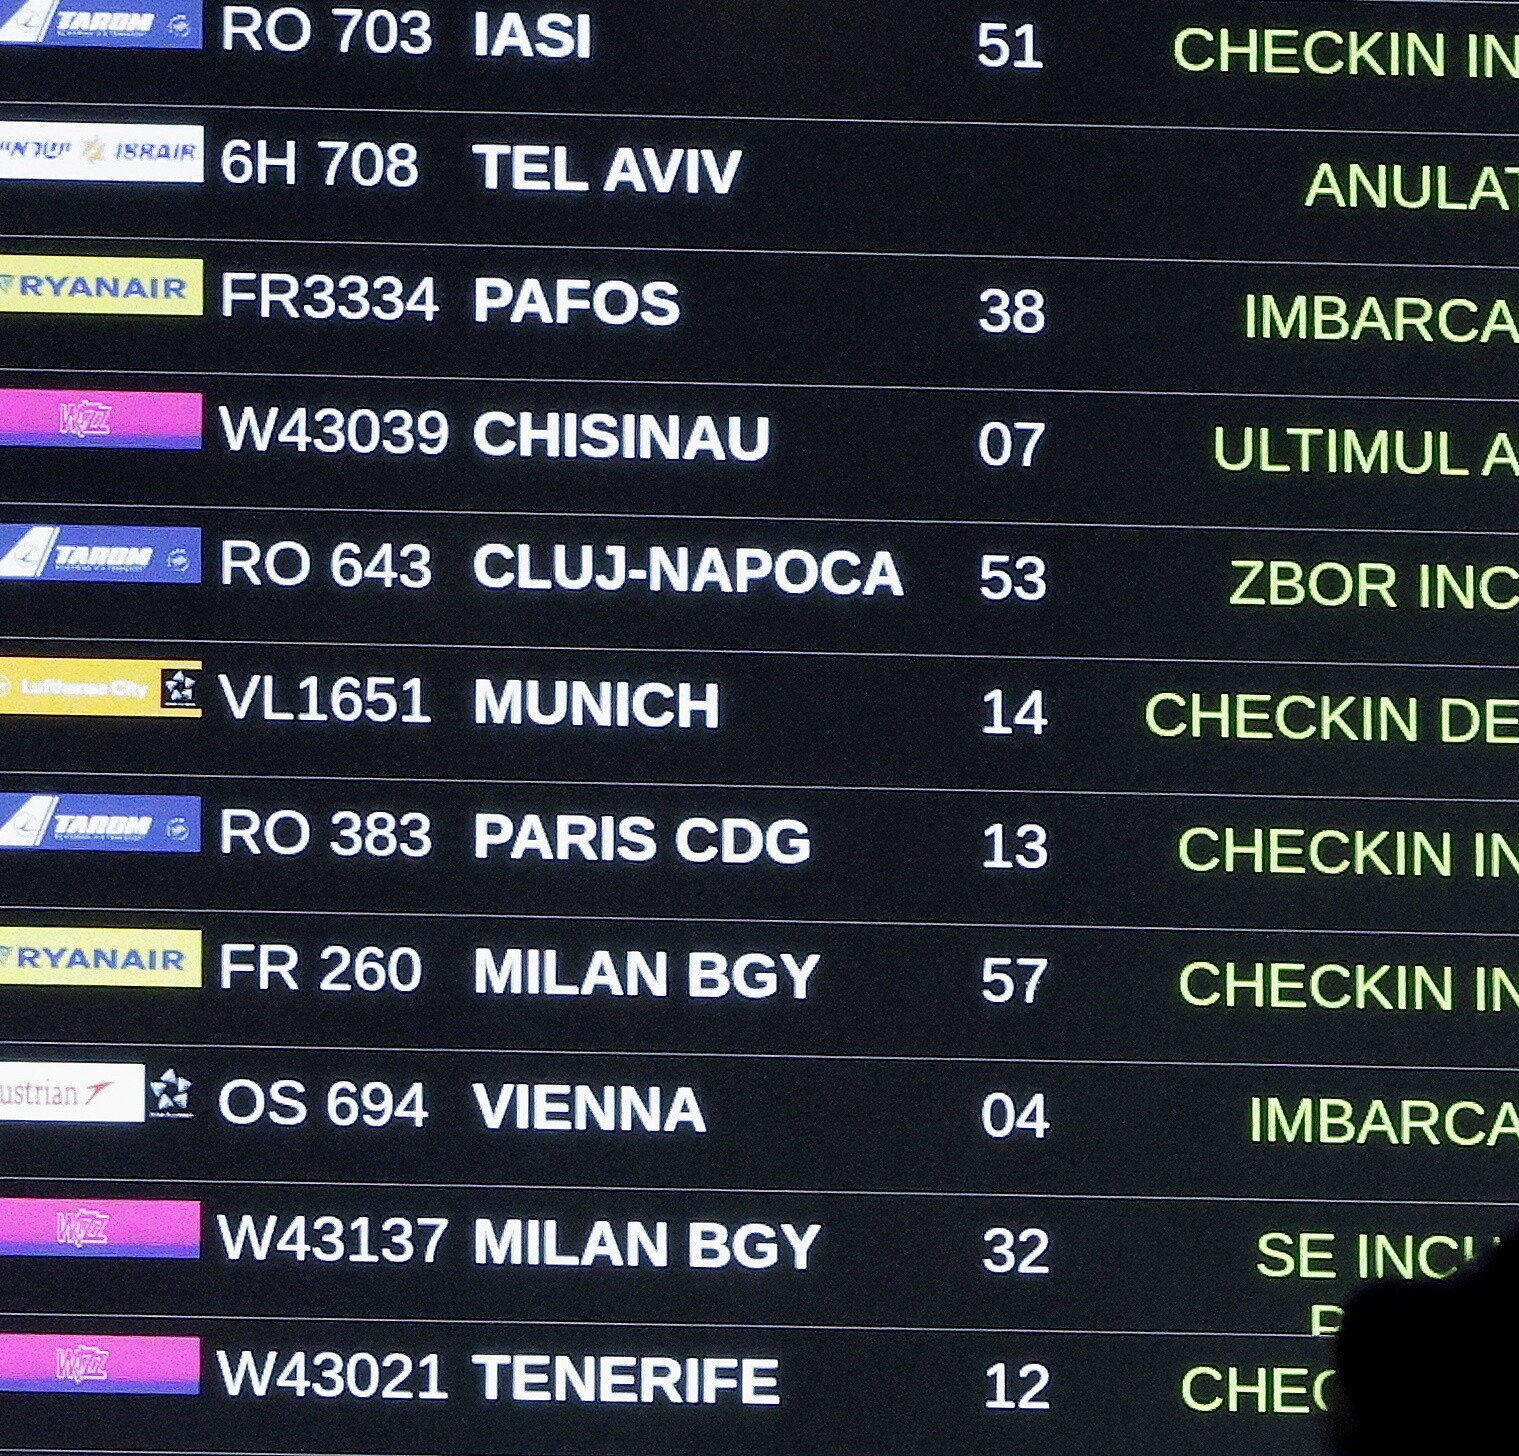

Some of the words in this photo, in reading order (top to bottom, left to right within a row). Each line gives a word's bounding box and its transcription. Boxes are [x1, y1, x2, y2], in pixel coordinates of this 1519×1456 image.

[56, 11, 156, 31] TAROM
[222, 5, 312, 52] RO
[331, 7, 432, 55] 703
[475, 11, 591, 59] IASI
[978, 22, 1044, 69] 51
[1174, 27, 1445, 77] CHECKIN
[115, 143, 197, 161] ISRAIR
[220, 139, 296, 185] 6H
[317, 140, 419, 188] 708
[471, 143, 590, 192] TEL
[603, 147, 743, 194] AVIV
[19, 275, 187, 300] RYANAIR
[222, 272, 440, 322] FR3334
[475, 277, 680, 326] PAFOS
[978, 288, 1045, 334] 38
[218, 405, 449, 455] W43039
[473, 410, 770, 462] CHISINAU
[978, 421, 1046, 467] 07
[1213, 426, 1470, 476] ULTIMUL
[55, 545, 155, 566] TAROM
[221, 539, 311, 586] RO
[330, 541, 432, 589] 643
[473, 543, 904, 597] CLUJ-NAPOCA
[980, 554, 1047, 601] 53
[1229, 560, 1397, 608] ZBOR
[20, 677, 108, 697] Lufthansa
[110, 679, 149, 700] City
[217, 673, 432, 723] VL1651
[474, 678, 719, 729] MUNICH
[982, 688, 1049, 735] 14
[1145, 692, 1418, 742] CHECKIN
[54, 814, 154, 835] TAROM
[221, 808, 310, 855] RO
[330, 810, 432, 858] 383
[475, 812, 657, 862] PARIS
[675, 817, 811, 865] CDG
[983, 823, 1048, 869] 13
[1178, 827, 1451, 877] CHECKIN
[17, 946, 185, 971] RYANAIR
[220, 943, 299, 990] FR
[319, 945, 422, 992] 260
[475, 947, 668, 997] MILAN
[688, 951, 821, 1000] BGY
[982, 957, 1048, 1004] 57
[1179, 961, 1452, 1011] CHECKIN
[218, 1078, 307, 1126] OS
[327, 1080, 429, 1128] 694
[472, 1082, 707, 1133] VIENNA
[981, 1092, 1050, 1138] 04
[216, 1214, 449, 1263] W43137
[474, 1218, 668, 1267] MILAN
[688, 1221, 822, 1270] BGY
[982, 1227, 1050, 1274] 32
[1256, 1232, 1337, 1279] SE
[216, 1350, 449, 1400] W43021
[471, 1354, 780, 1405] TENERIFE
[985, 1362, 1050, 1410] 12
